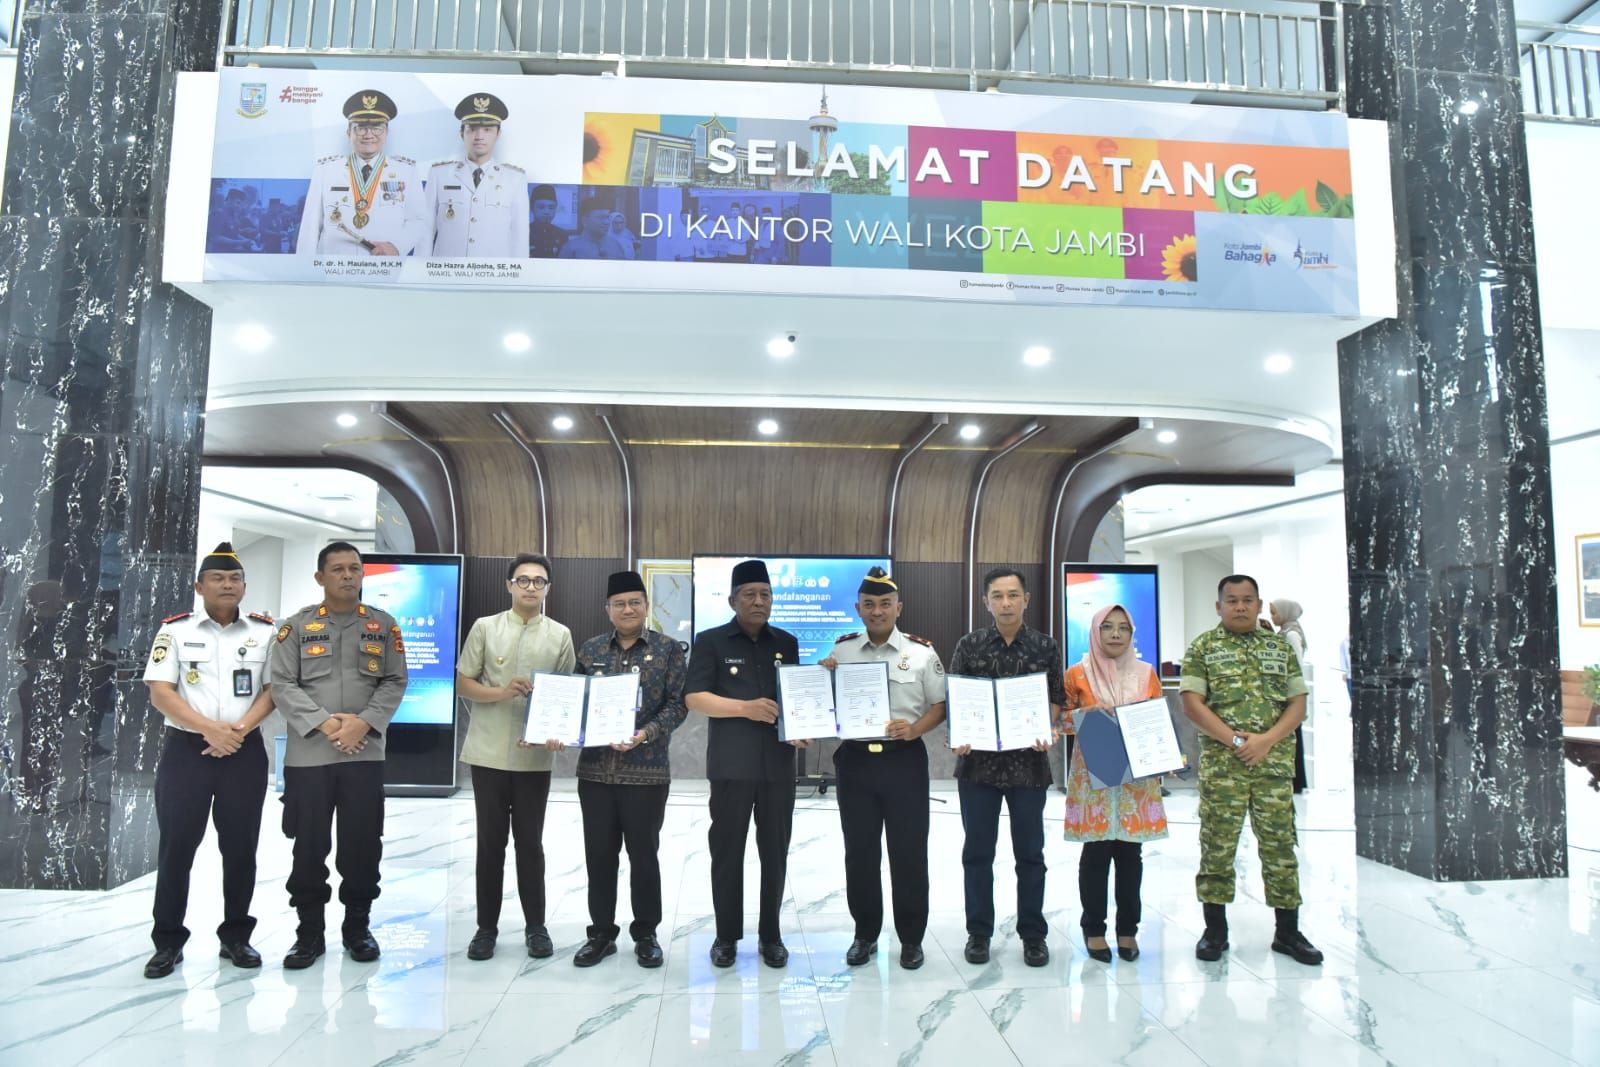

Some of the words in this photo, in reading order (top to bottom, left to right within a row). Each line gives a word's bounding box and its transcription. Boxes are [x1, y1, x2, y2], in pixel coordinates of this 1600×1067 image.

[707, 137, 991, 187] SELAMAT
[1016, 151, 1260, 199] DATANG
[639, 212, 674, 239] DI
[686, 214, 833, 244] KANTOR
[845, 219, 933, 249] WALI
[944, 223, 1035, 253] KOTA
[1044, 229, 1146, 257] JAMBI
[361, 633, 386, 641] POLRI
